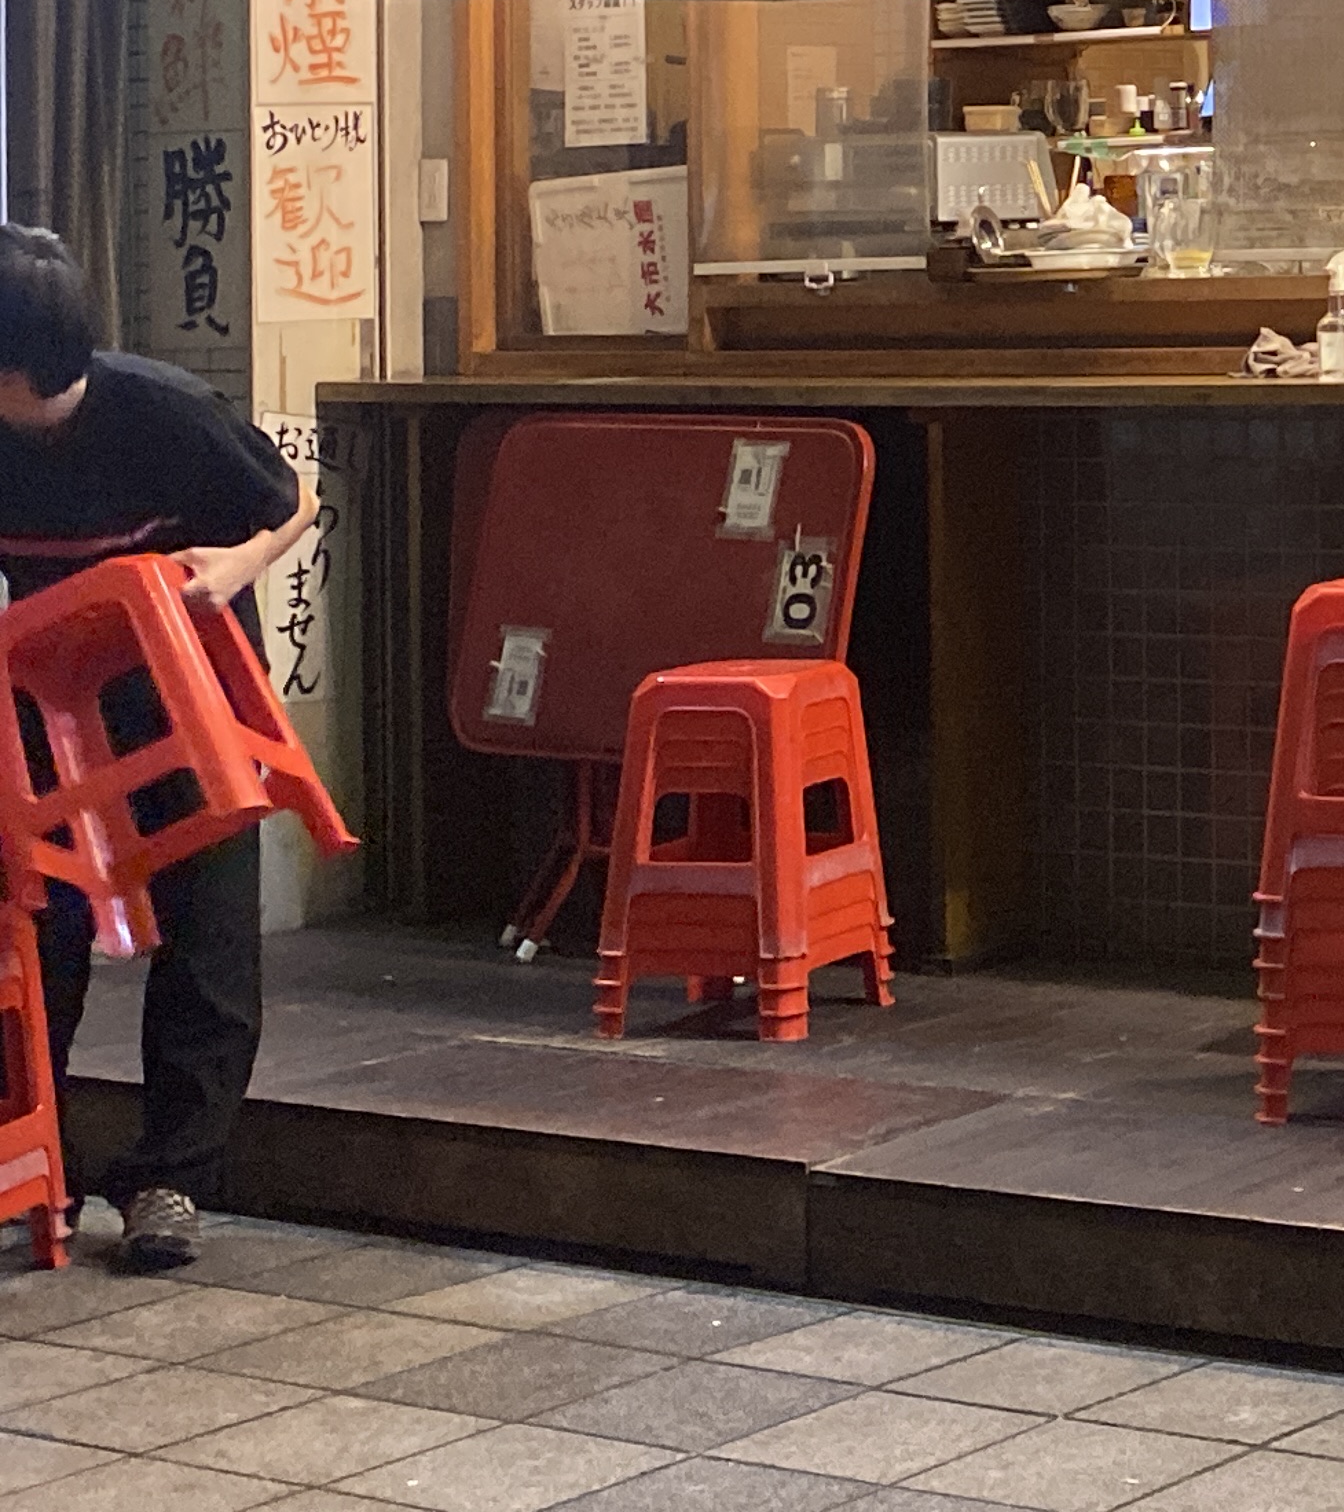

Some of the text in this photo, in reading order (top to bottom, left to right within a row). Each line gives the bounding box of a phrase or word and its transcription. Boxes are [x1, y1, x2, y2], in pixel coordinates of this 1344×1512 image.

[262, 109, 367, 156] おひとり様
[265, 163, 366, 306] 歓迎
